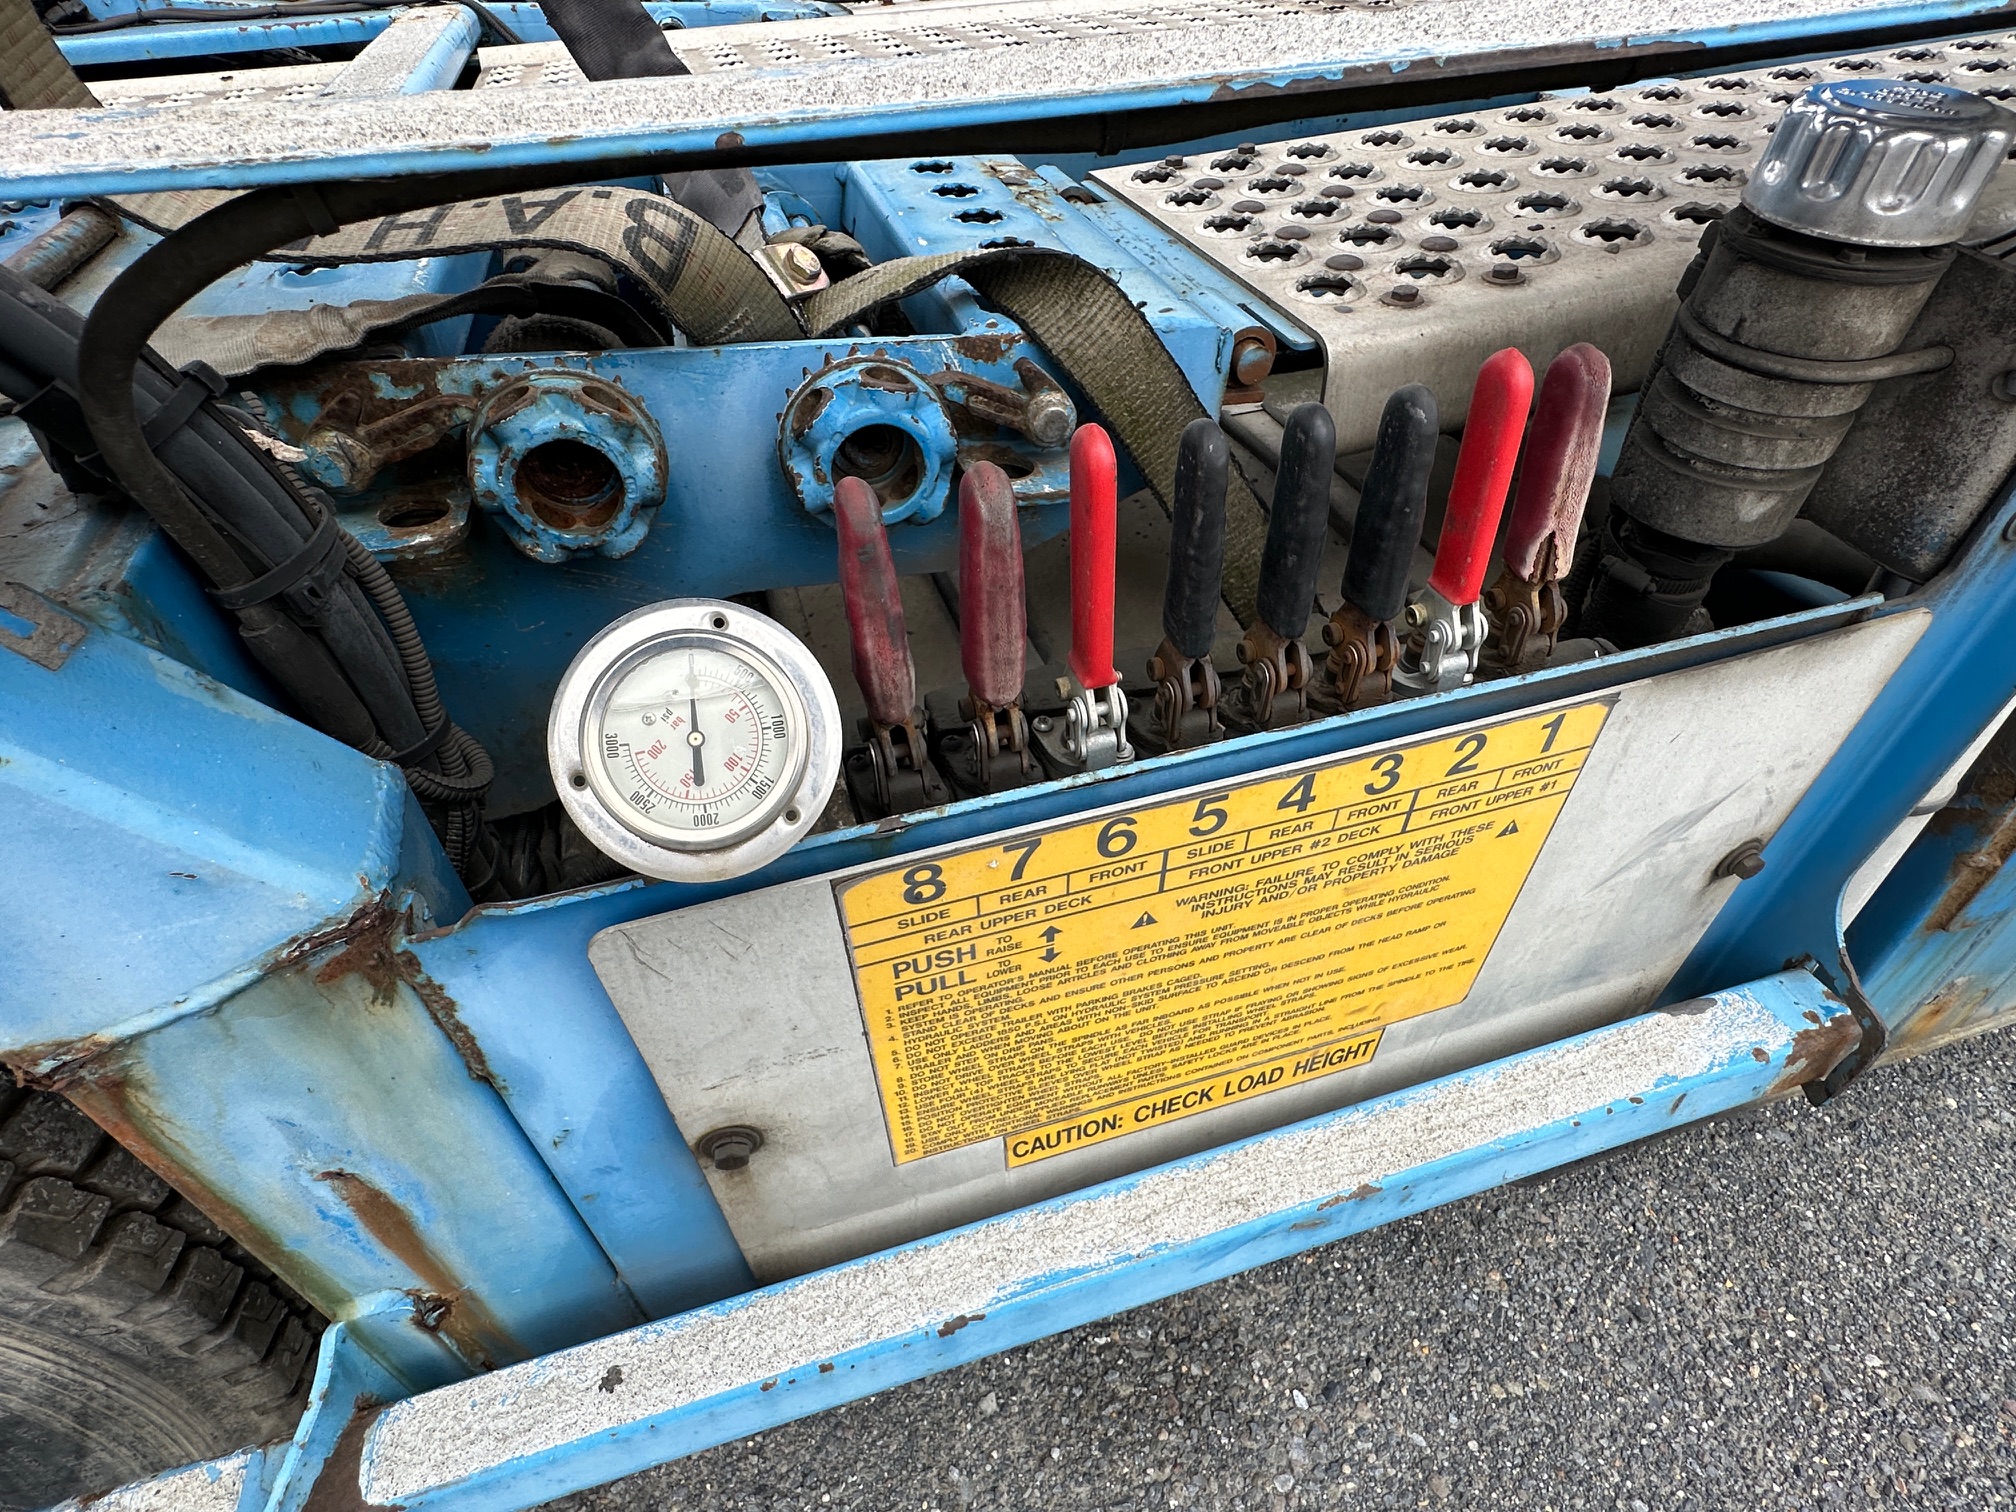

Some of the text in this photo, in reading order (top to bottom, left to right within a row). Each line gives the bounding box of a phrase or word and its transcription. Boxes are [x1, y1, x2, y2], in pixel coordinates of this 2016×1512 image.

[734, 665, 753, 682] 500
[660, 707, 674, 724] psi
[670, 716, 686, 731] bar
[724, 707, 741, 724] 50
[770, 713, 787, 739] 1000
[604, 733, 619, 759] 3000
[1539, 712, 1566, 754] 1
[647, 739, 667, 760] 200
[724, 753, 743, 773] 100
[1444, 732, 1487, 777] 2
[1363, 753, 1403, 795] 3
[1511, 758, 1564, 780] FRONT
[630, 790, 656, 815] 2500
[752, 776, 775, 800] 1500
[1276, 772, 1317, 814] 4
[1429, 779, 1557, 820] FRONT UPPER #1
[1436, 780, 1478, 798] REAR
[693, 812, 720, 827] 2000
[1188, 793, 1229, 836] 5
[1346, 798, 1402, 821] FRONT
[1096, 816, 1137, 858] 6
[1269, 820, 1313, 839] REAR
[1002, 837, 1041, 881] 7
[1175, 820, 1495, 907] WARNING: FAILURE TO COMPLY WITH THESE
[1186, 839, 1235, 859] SLIDE
[1188, 824, 1381, 879] FRONT UPPER #2 DECK
[903, 863, 945, 904] 8
[1088, 860, 1147, 883] FRONT
[1190, 834, 1474, 912] INSTRUCTIONS MAY RESULT IN SERIOUS
[1201, 846, 1460, 919] INJURY AND/OR PROPERTY DAMAGE
[999, 885, 1047, 905] REAR
[897, 908, 950, 929] SLIDE
[923, 894, 1091, 944] REAR UPPER DECK
[898, 1001, 943, 1018] INSPECT
[949, 996, 969, 1006] ALL
[973, 979, 1033, 1000] EQUIPMENT
[1038, 970, 1070, 983] PRIOR
[1075, 965, 1088, 974] TO
[1092, 957, 1121, 969] EACH
[1124, 951, 1145, 961] USE
[1150, 947, 1163, 955] TO
[1167, 936, 1208, 951] ENSURE
[1212, 920, 1270, 940] EQUIPMENT
[1273, 917, 1283, 925] IS
[1286, 914, 1297, 922] IN
[1299, 903, 1338, 918] PROPER
[1341, 889, 1394, 907] OPERATING
[1397, 874, 1450, 893] CONDITION.
[899, 1013, 928, 1025] KEEP
[932, 1002, 973, 1017] HANDS,
[977, 992, 1012, 1006] LIMBS,
[1016, 981, 1052, 996] LOOSE
[1057, 968, 1106, 986] ARTICLES
[1110, 961, 1132, 972] AND
[1136, 948, 1187, 965] CLOTHING
[1190, 941, 1216, 953] AWAY
[1219, 933, 1249, 945] FROM
[1251, 919, 1304, 937] MOVEABLE
[1308, 907, 1352, 923] OBJECTS
[1356, 898, 1385, 911] WHILE
[1387, 884, 1440, 903] HYDRAULIC
[986, 940, 1022, 956] RAISE
[995, 934, 1012, 944] TO
[892, 943, 976, 979] PUSH
[897, 997, 933, 1011] REFER
[938, 993, 953, 1001] TO
[956, 974, 1024, 997] OPERATOR'S
[1028, 963, 1072, 979] MANUAL
[1076, 951, 1118, 967] BEFORE
[1122, 936, 1180, 955] OPERATING
[1185, 929, 1206, 940] THIS
[1210, 922, 1235, 933] UNIT.
[902, 1025, 937, 1038] STAND
[941, 1015, 976, 1028] CLEAR
[980, 1010, 995, 1019] OF
[999, 1000, 1035, 1014] DECKS
[1039, 993, 1060, 1004] AND
[1064, 982, 1105, 997] ENSURE
[1109, 972, 1143, 986] OTHER
[1147, 960, 1195, 977] PERSONS
[1198, 954, 1219, 964] AND
[1222, 940, 1274, 958] PROPERTY
[1276, 934, 1296, 945] ARE
[1299, 926, 1331, 939] CLEAR
[1334, 921, 1348, 930] OF
[1350, 912, 1383, 926] DECKS
[1385, 901, 1423, 916] BEFORE
[1425, 887, 1475, 906] OPERATING
[986, 964, 1021, 979] LOWER
[995, 959, 1012, 970] TO
[894, 970, 977, 1001] PULL
[901, 1016, 945, 1031] SYSTEM
[963, 996, 1024, 1016] OPERATING.
[904, 1043, 921, 1053] DO
[924, 1037, 945, 1047] NOT
[950, 1024, 996, 1040] OPERATE
[1001, 1012, 1042, 1027] TRAILER
[1046, 1004, 1071, 1015] WITH
[1075, 993, 1118, 1009] PARKING
[1122, 981, 1162, 997] BRAKES
[1166, 972, 1201, 985] CAGED.
[903, 1013, 1011, 1045] HYDRAULIC SYSTEM.
[911, 1083, 927, 1092] DO
[930, 1076, 950, 1086] NOT
[954, 1068, 983, 1080] DRIVE
[988, 1060, 1014, 1071] OVER
[1018, 1050, 1051, 1063] WHEEL
[1056, 1039, 1093, 1053] STRAPS
[1097, 1031, 1121, 1042] WITH
[1124, 1018, 1171, 1035] VEHICLES.
[1012, 1038, 1375, 1157] CAUTION: CHECK LOAD HEIGHT
